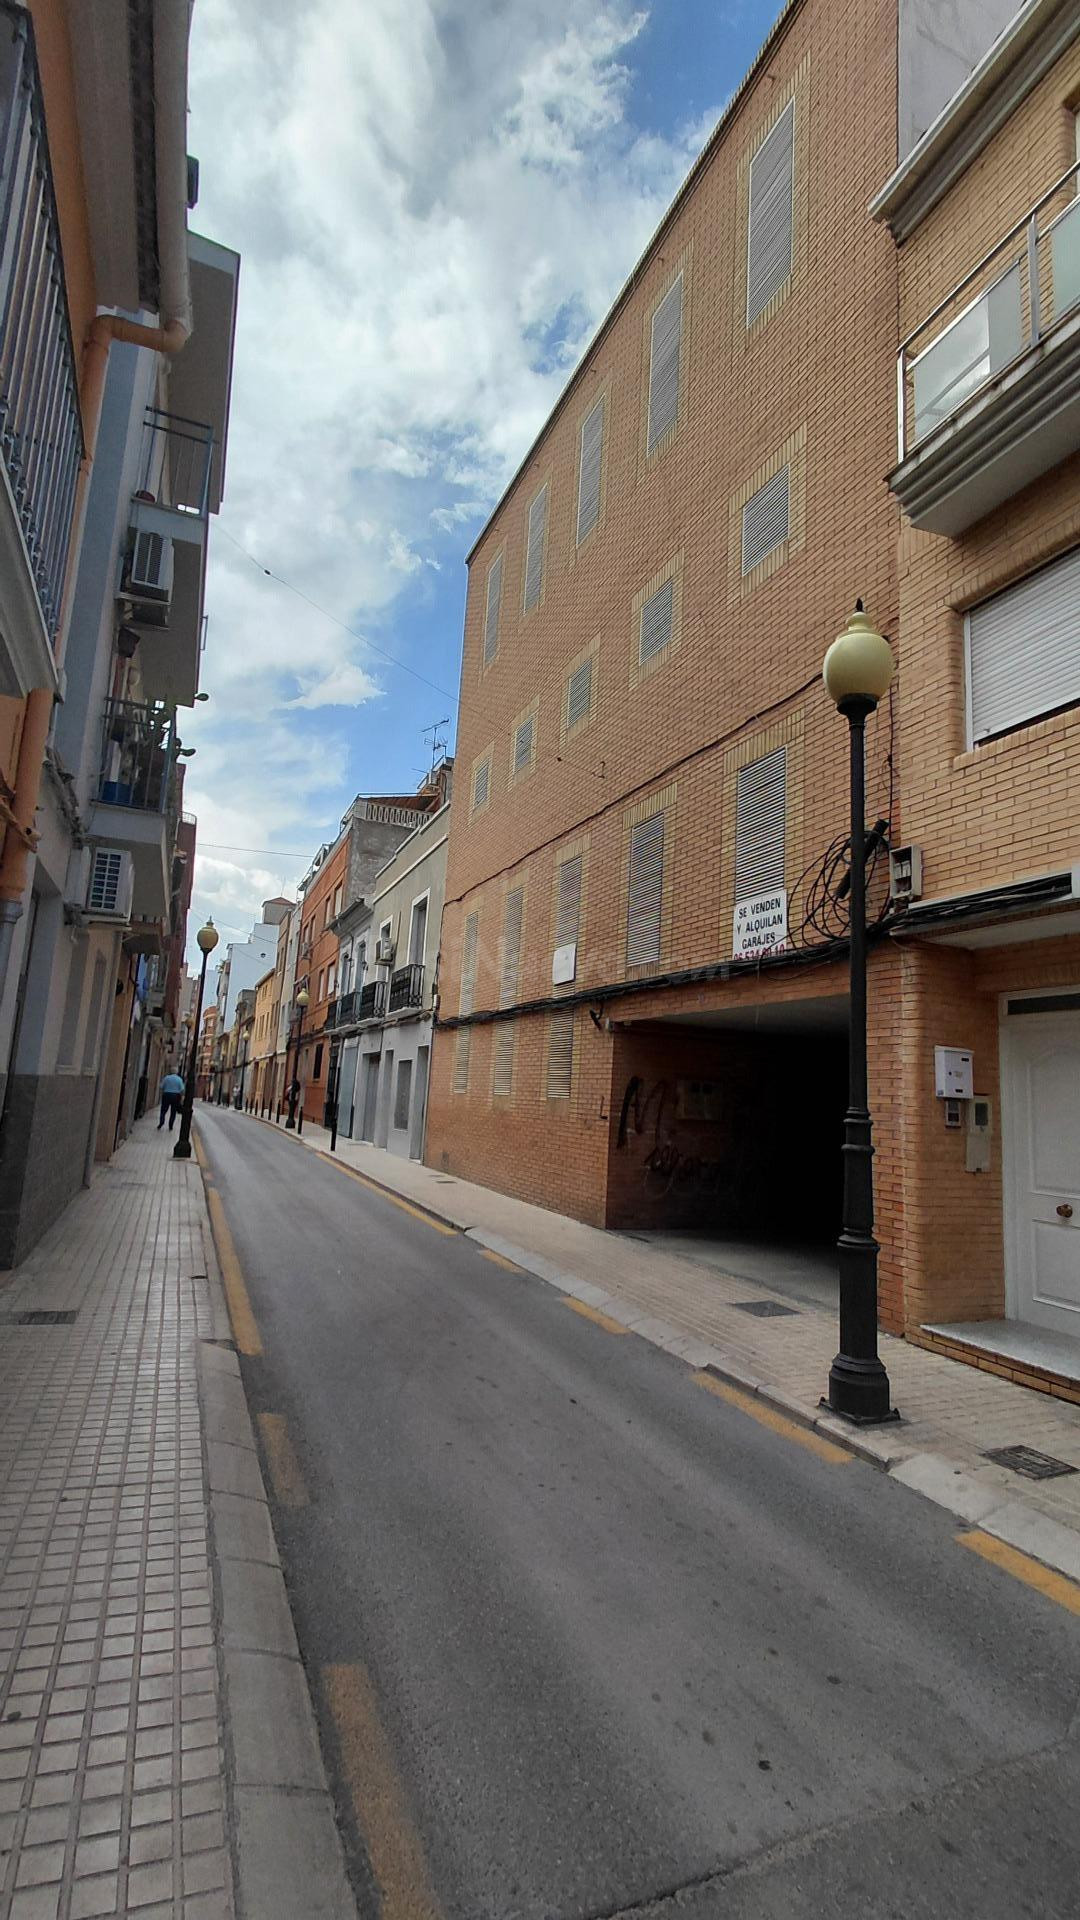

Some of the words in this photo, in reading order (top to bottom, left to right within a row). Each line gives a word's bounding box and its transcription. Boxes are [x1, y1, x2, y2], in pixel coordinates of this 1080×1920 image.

[738, 907, 747, 919] SE
[751, 898, 781, 915] VENDEN
[737, 924, 742, 935] Y
[745, 914, 782, 933] ALQUILAN
[742, 932, 775, 949] GARAJES
